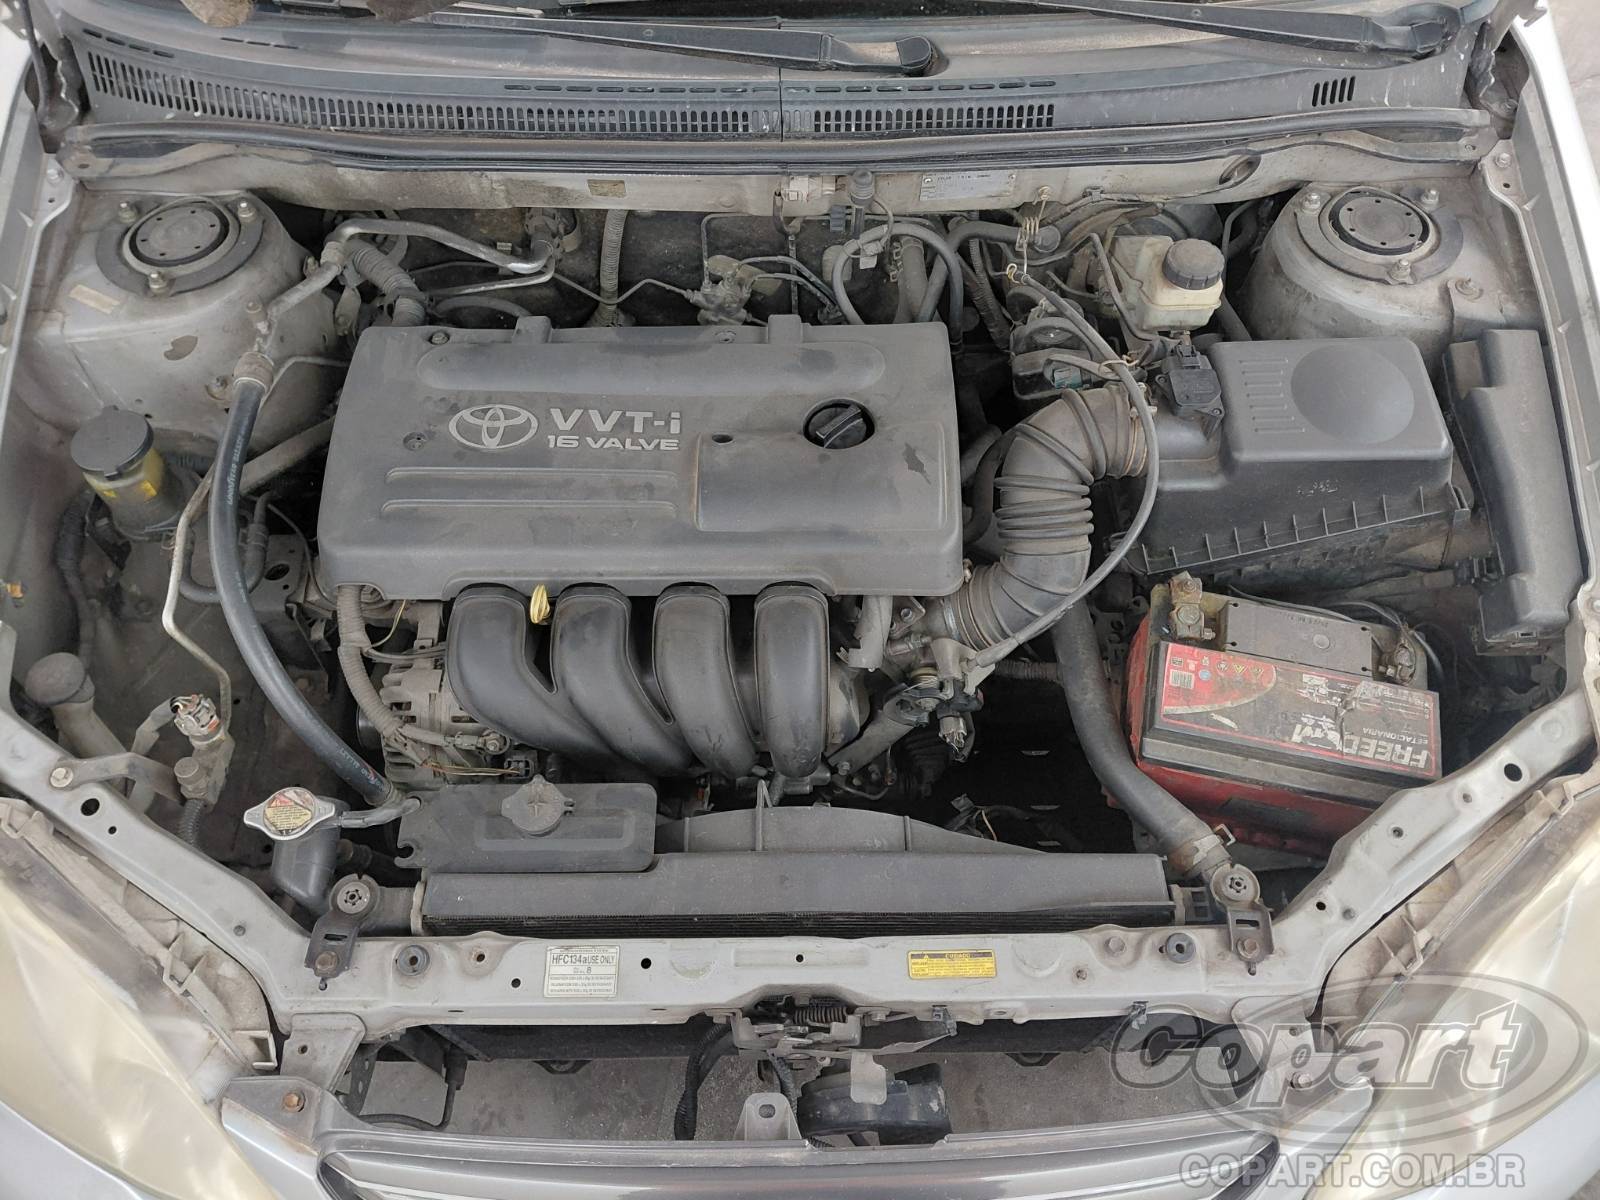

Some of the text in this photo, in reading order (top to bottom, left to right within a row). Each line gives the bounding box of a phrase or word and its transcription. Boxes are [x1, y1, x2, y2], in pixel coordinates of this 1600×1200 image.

[549, 408, 682, 434] VVT-i
[547, 435, 681, 451] 16 VALVE
